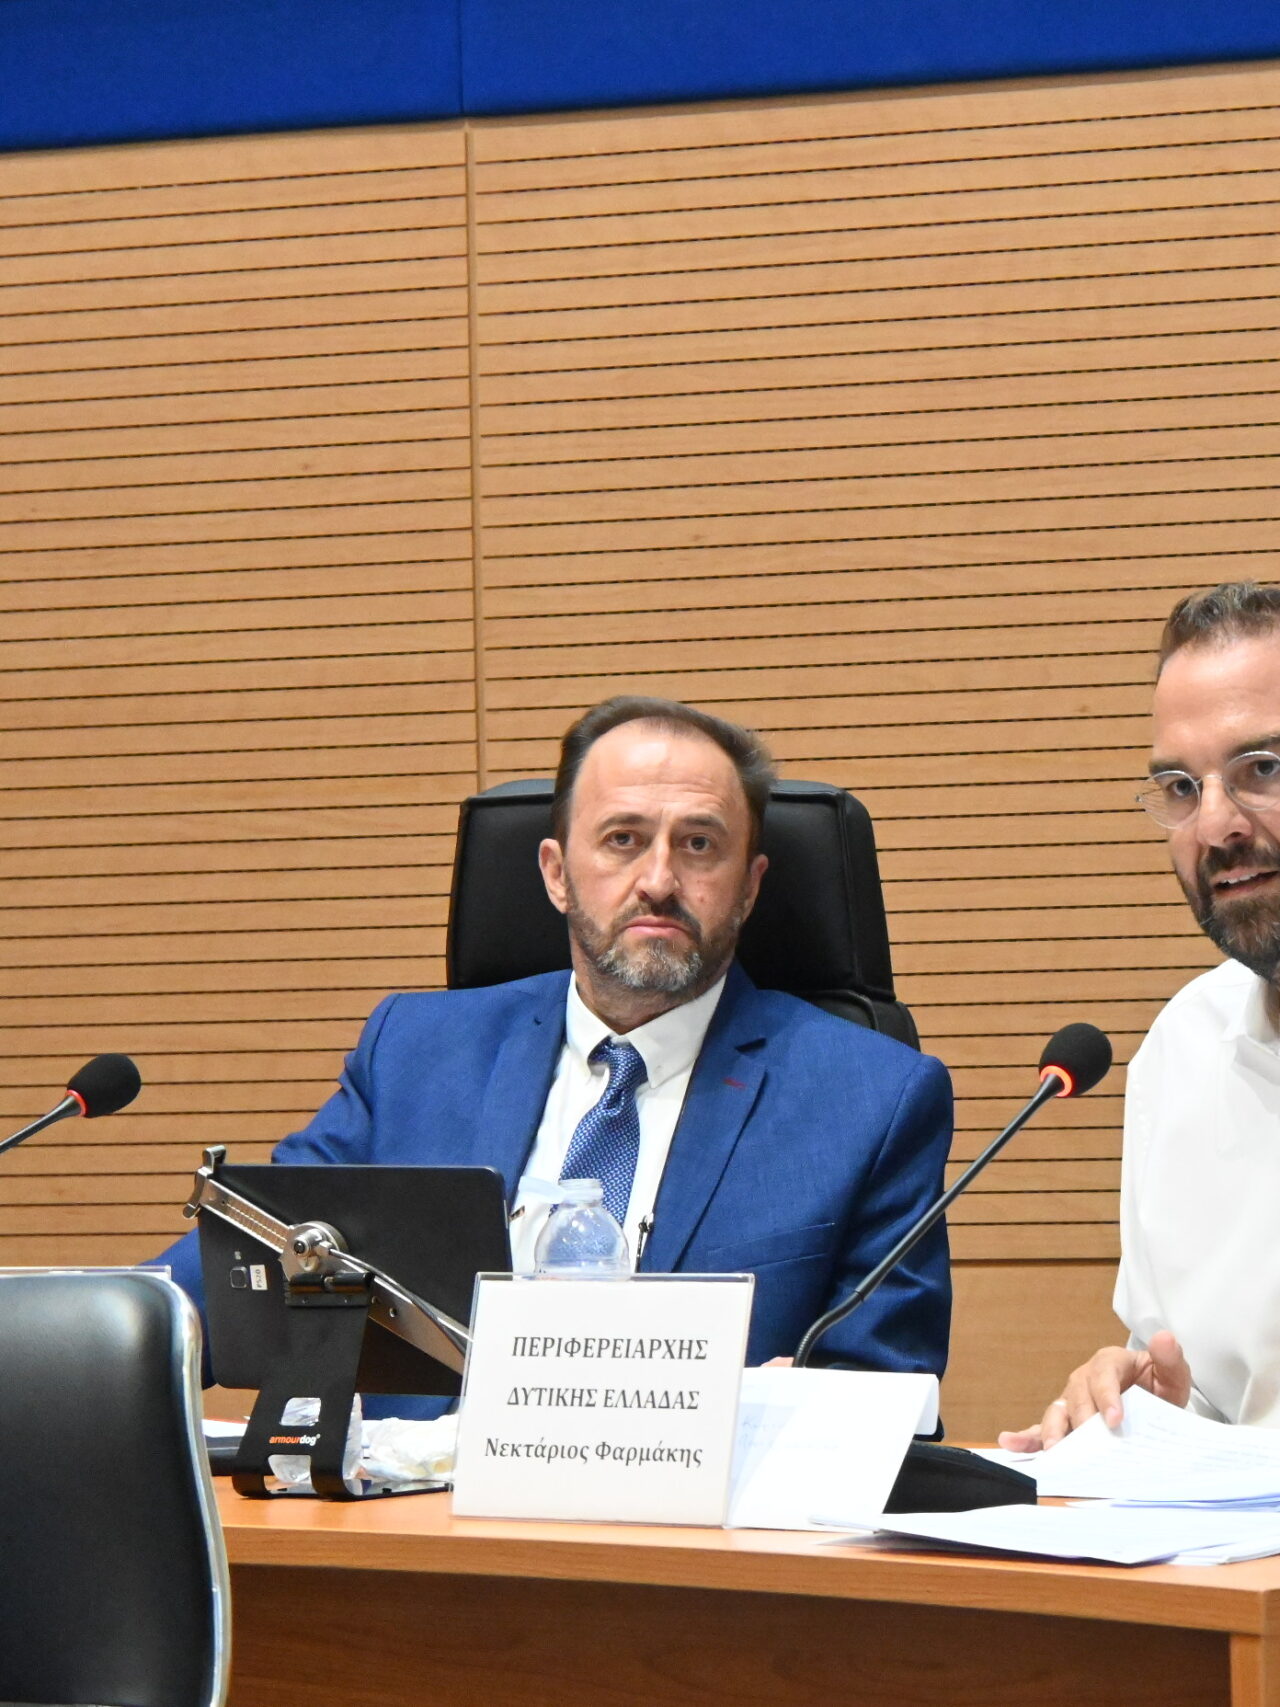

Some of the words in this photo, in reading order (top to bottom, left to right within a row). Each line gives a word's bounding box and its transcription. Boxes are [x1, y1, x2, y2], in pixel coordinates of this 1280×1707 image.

[512, 1336, 708, 1360] ΠΕΡΙΦΕΡΕΙΑΡΧΗΣ
[507, 1387, 597, 1407] ΔΥΤΙΚΗΣ
[603, 1389, 699, 1410] ΕΛΛΑΔΑΣ
[485, 1437, 589, 1464] Νεκτάριος
[595, 1440, 703, 1468] Φαρμάκης
